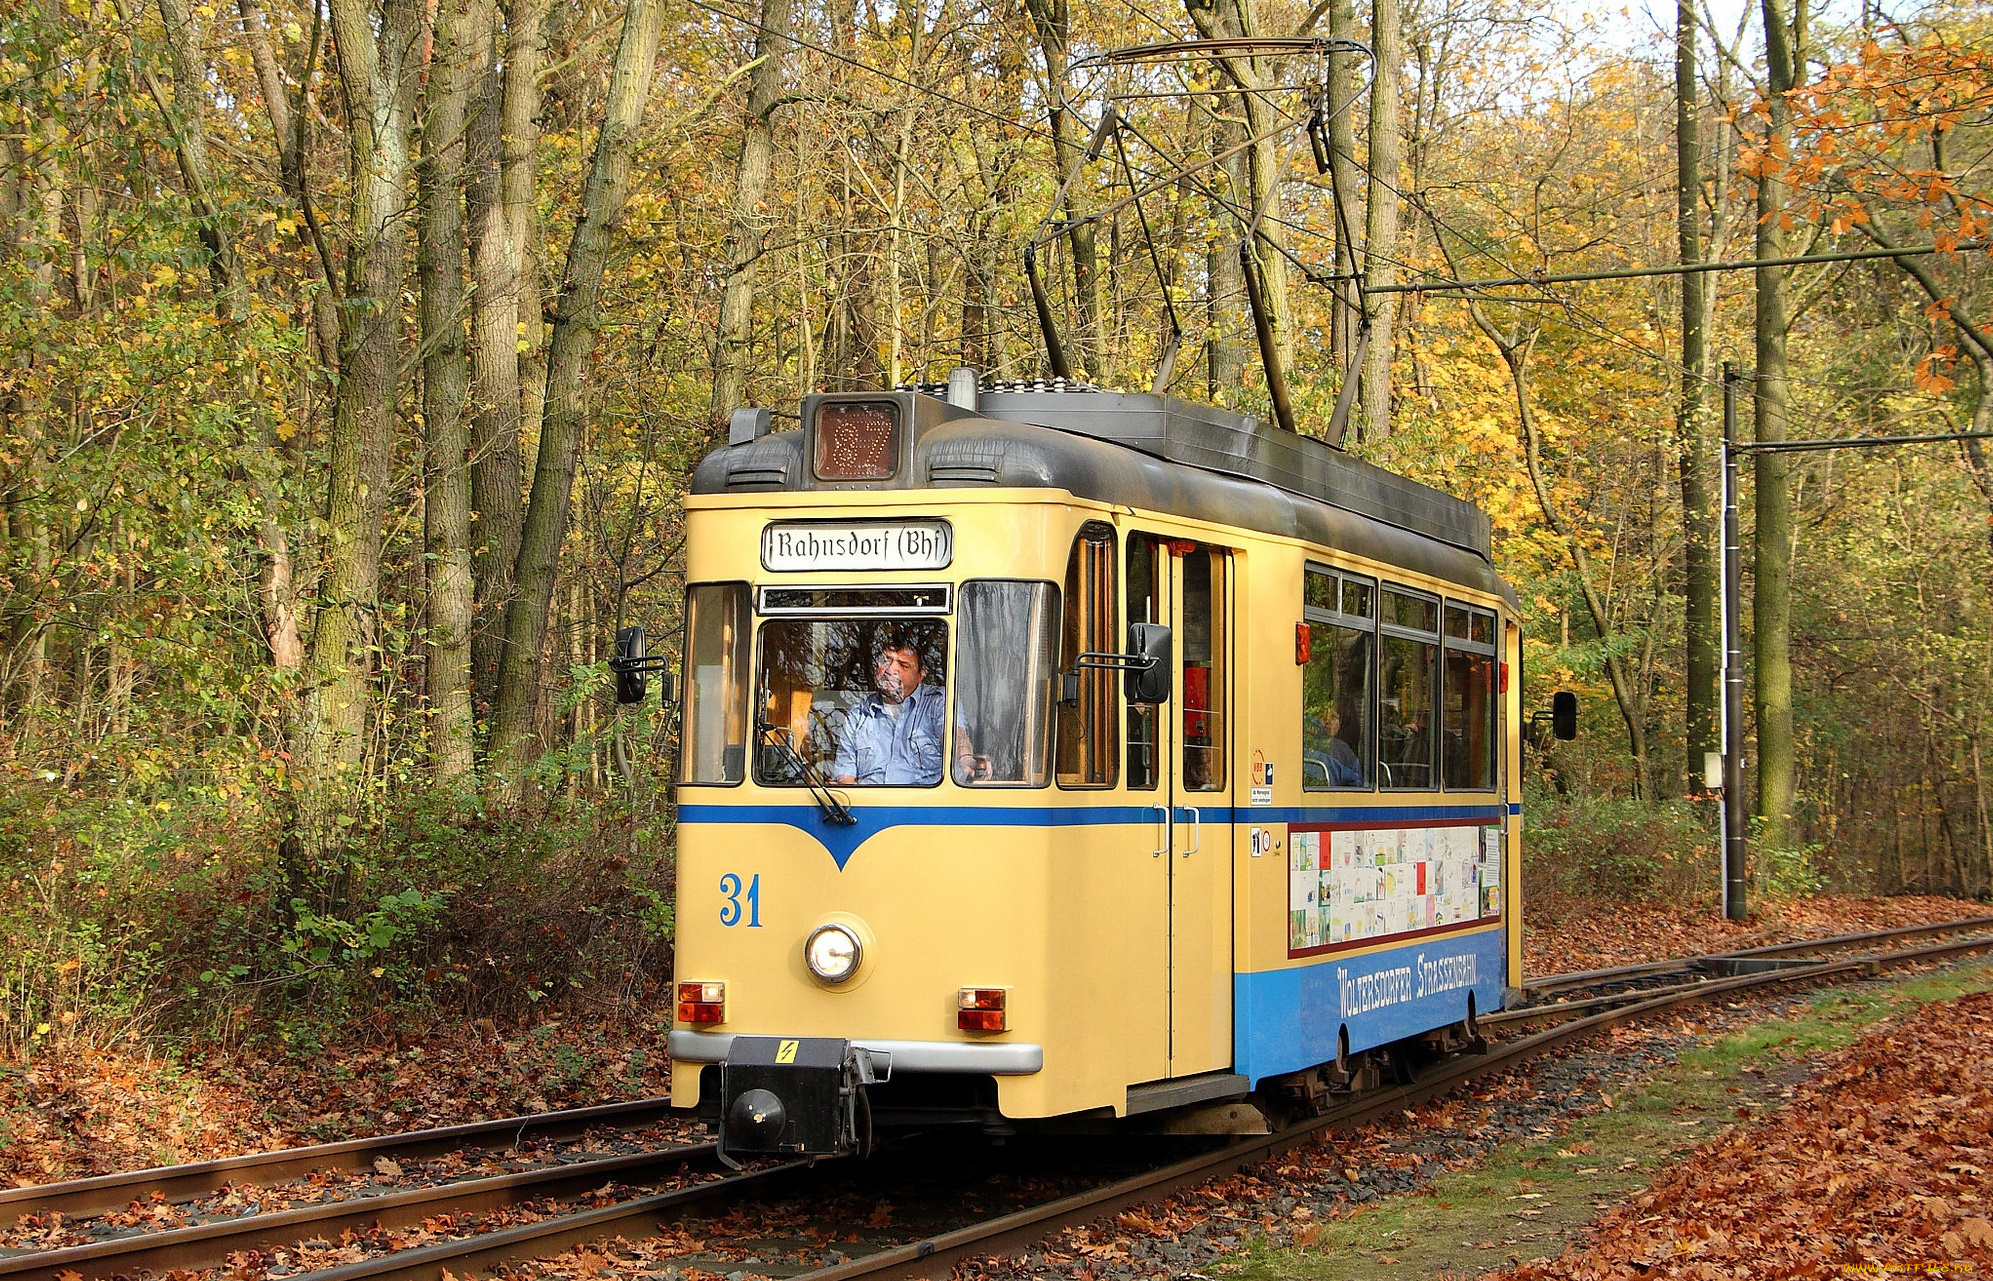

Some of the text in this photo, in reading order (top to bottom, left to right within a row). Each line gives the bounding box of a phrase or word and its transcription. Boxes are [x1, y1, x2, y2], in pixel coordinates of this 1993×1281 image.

[832, 421, 892, 468] 87
[777, 525, 949, 563] Rahnsdorf (Bhf)
[719, 872, 763, 928] 31
